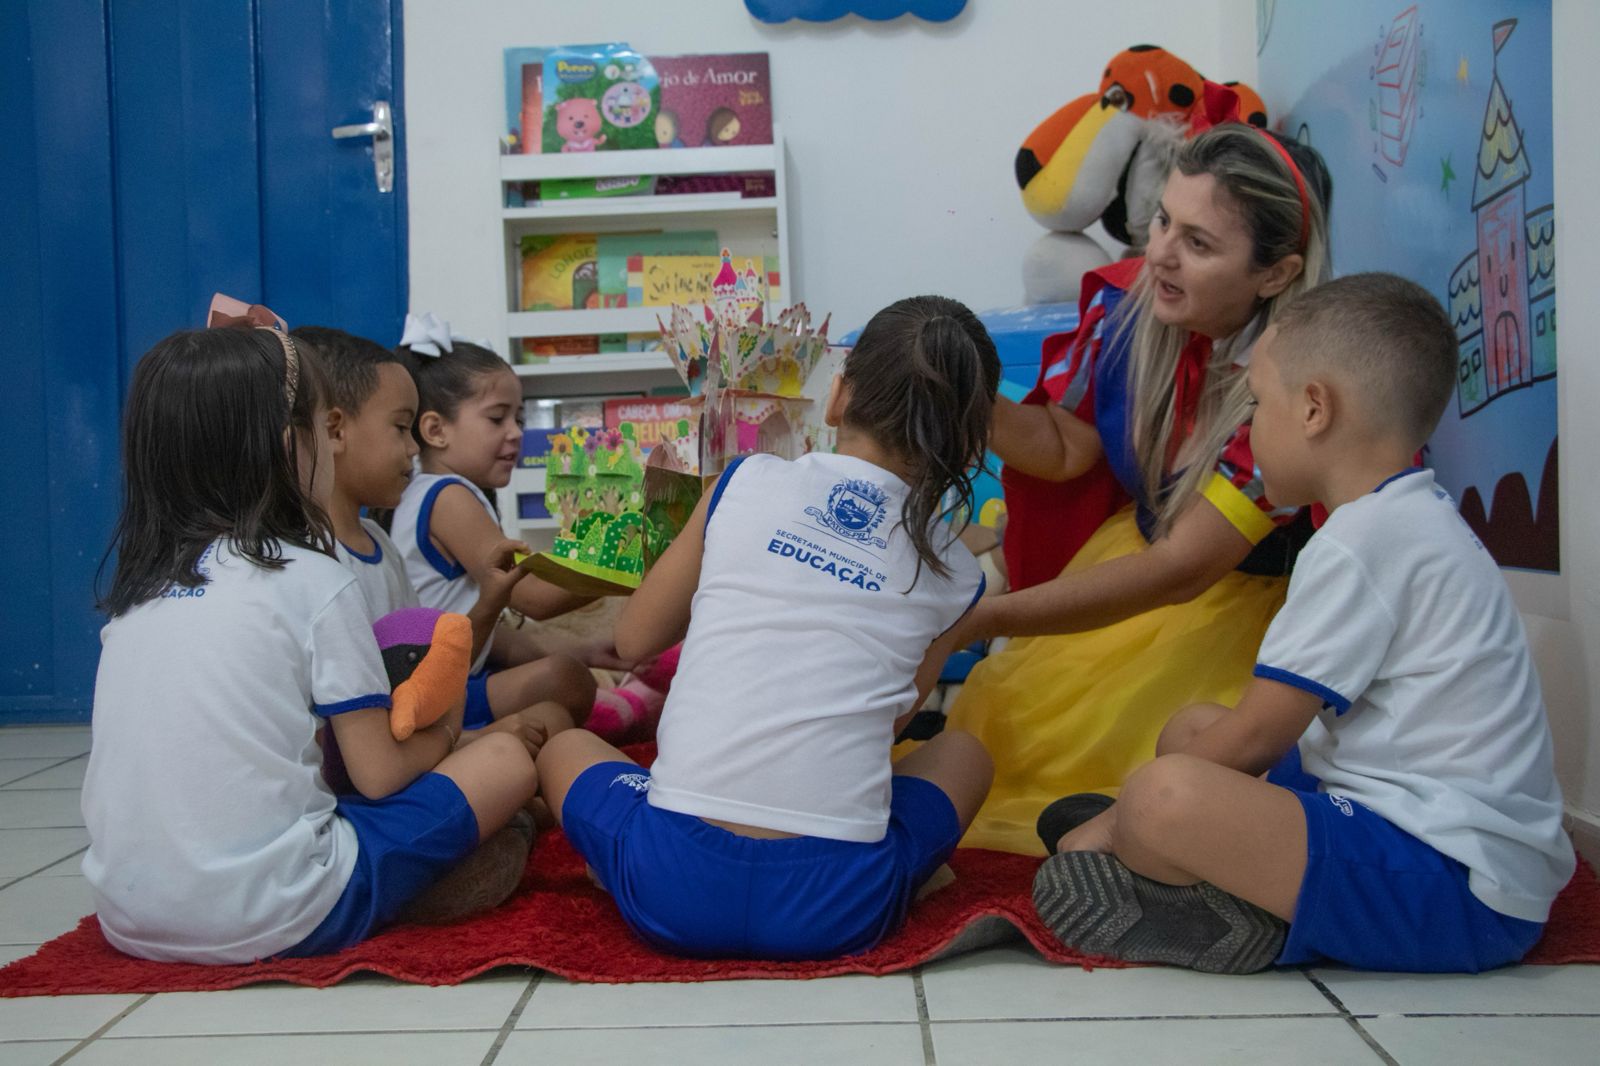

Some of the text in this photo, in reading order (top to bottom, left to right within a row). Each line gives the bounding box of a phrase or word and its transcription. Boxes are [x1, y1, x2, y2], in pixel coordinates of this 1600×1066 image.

[703, 67, 758, 85] Amor
[767, 538, 881, 592] EDUCAÇÃO
[776, 529, 888, 583] SECRETARIA MUNICIPAL DE
